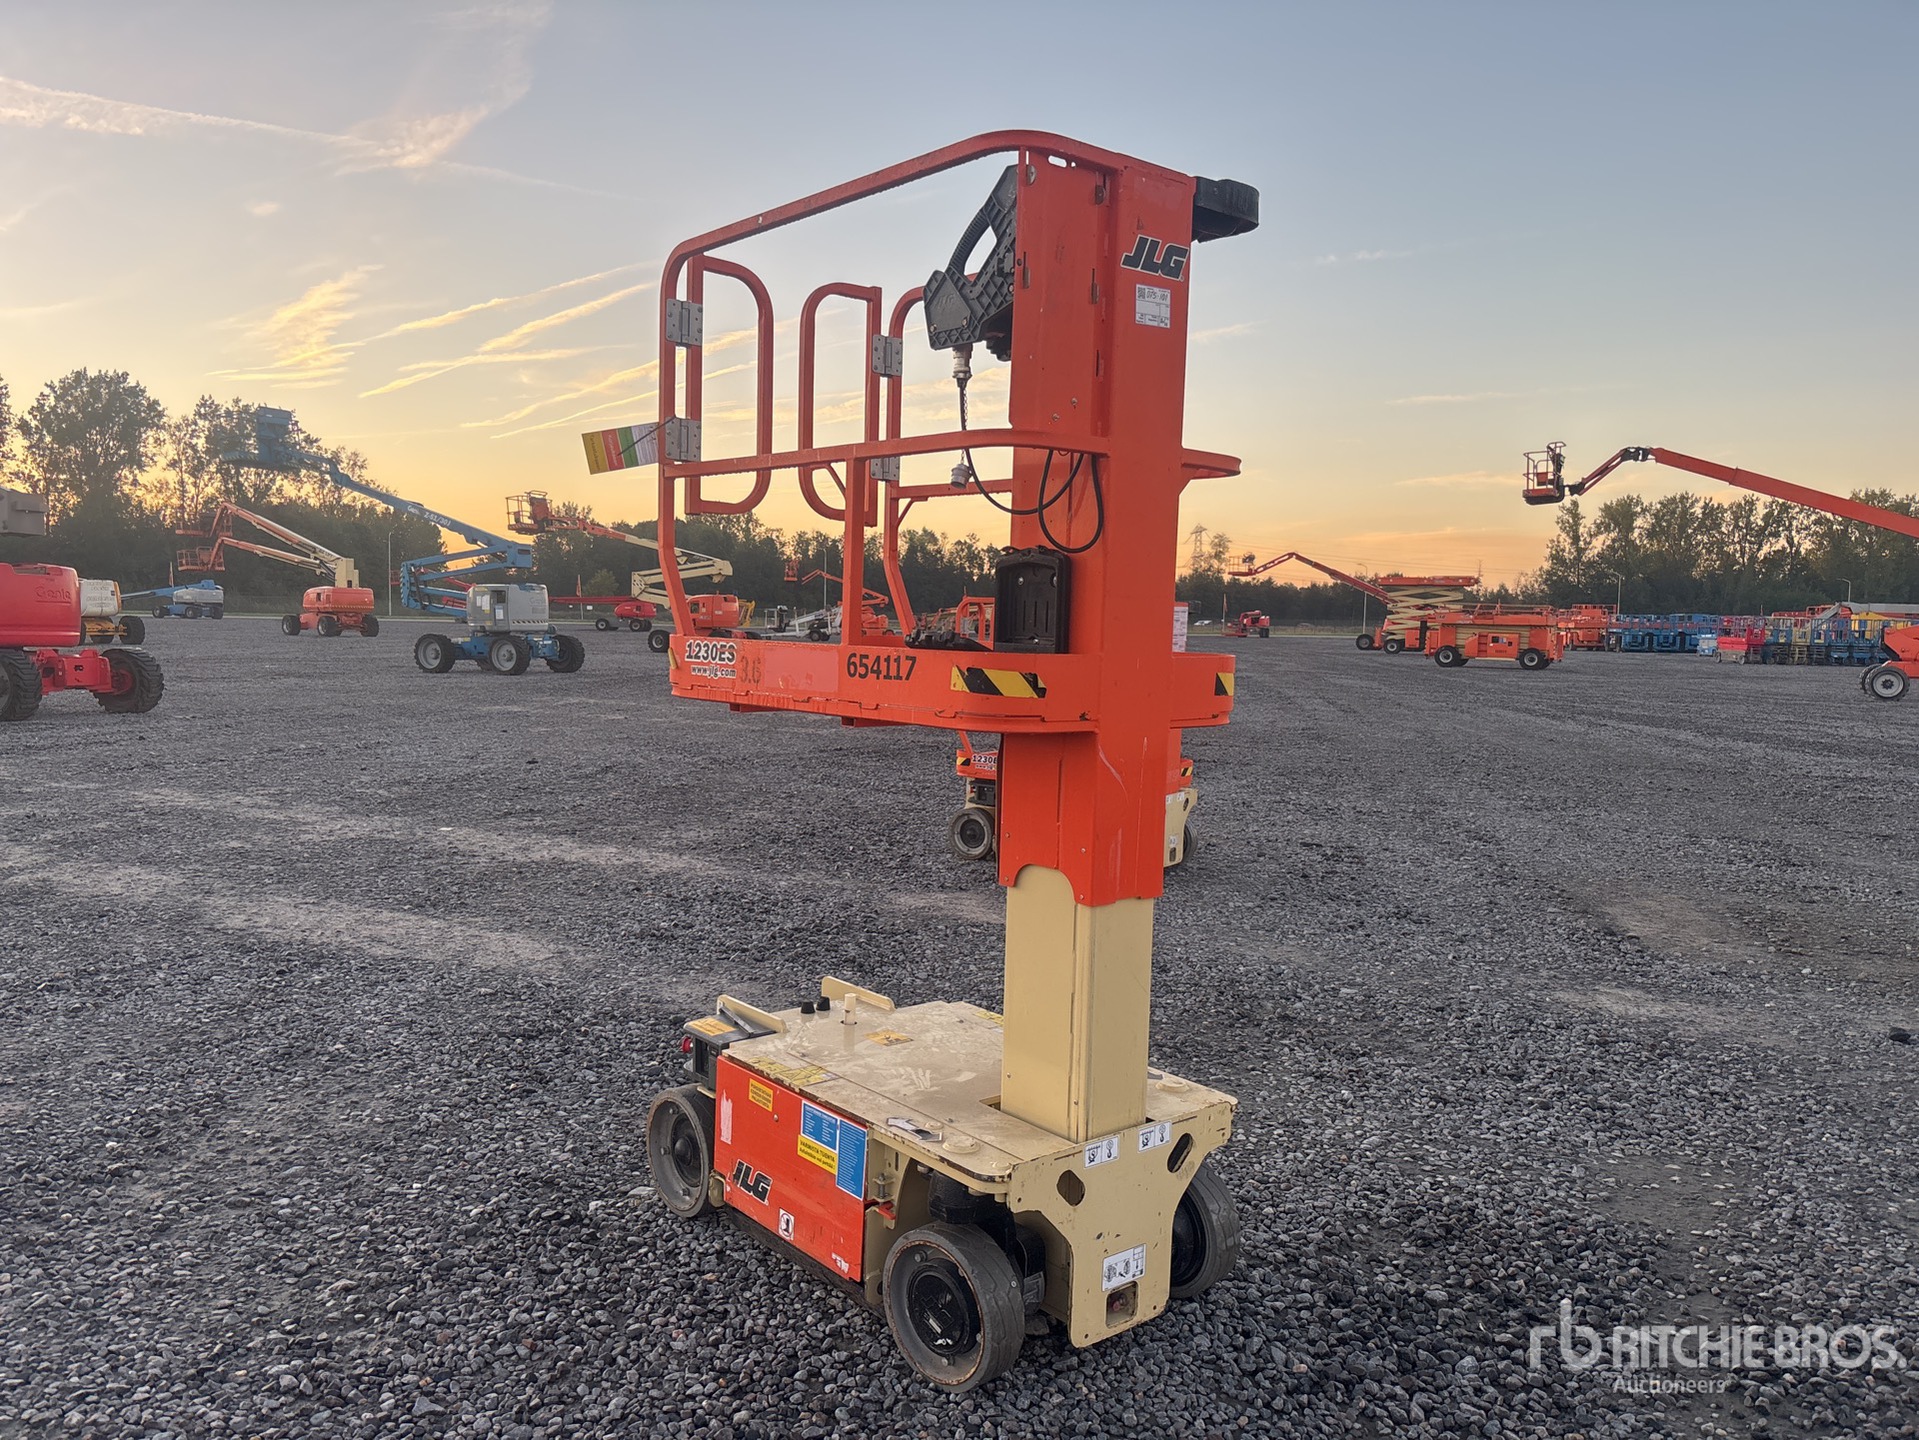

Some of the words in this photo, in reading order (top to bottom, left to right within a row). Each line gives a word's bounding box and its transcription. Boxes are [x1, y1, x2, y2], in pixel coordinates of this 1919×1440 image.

[1121, 234, 1189, 281] JLG
[684, 640, 738, 665] 1230ES
[690, 664, 737, 680] www.jlg.com
[847, 652, 917, 681] 654117
